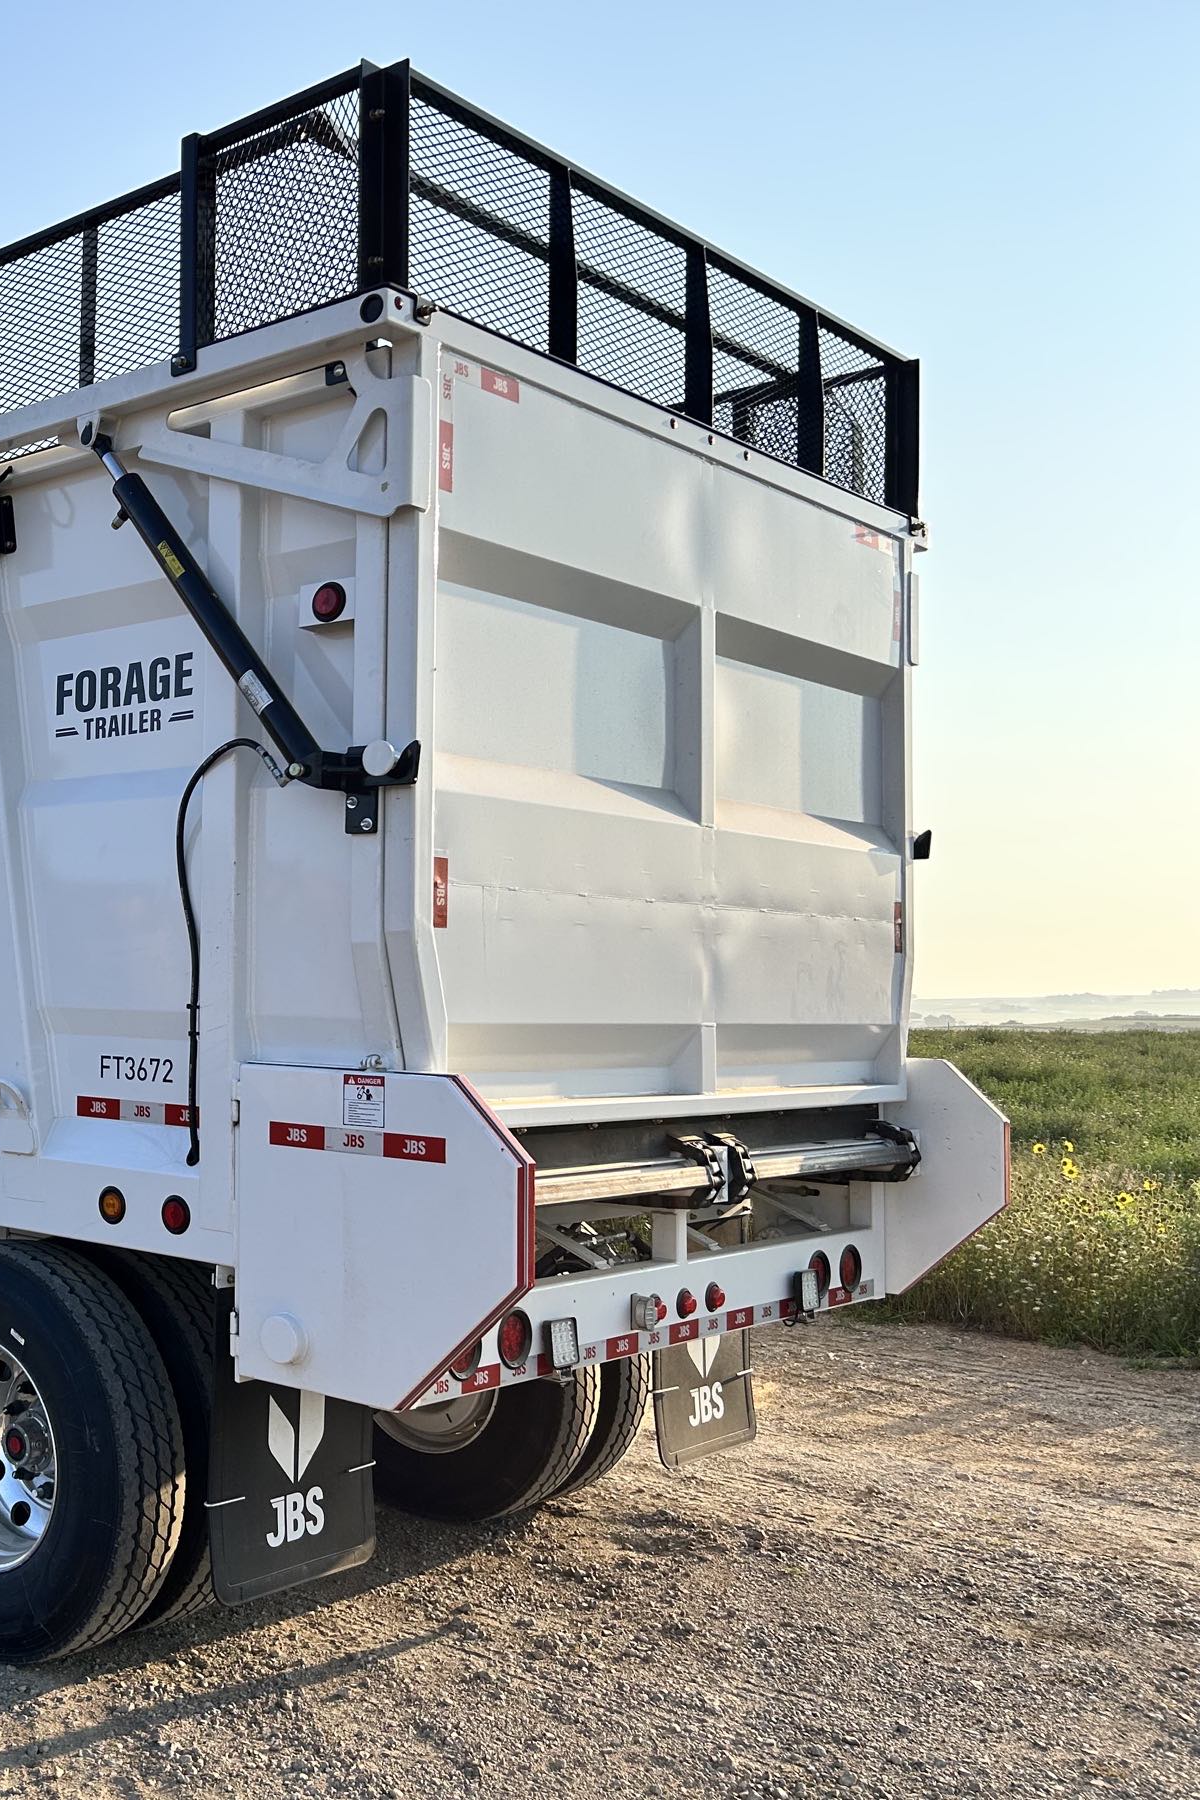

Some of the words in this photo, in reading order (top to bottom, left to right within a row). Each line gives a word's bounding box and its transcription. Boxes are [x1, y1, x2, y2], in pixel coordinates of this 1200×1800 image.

[443, 373, 452, 400] JBS
[454, 361, 469, 378] JBS
[493, 377, 508, 394] JBS
[441, 442, 451, 470] JBS
[56, 652, 194, 716] FORAGE
[83, 708, 162, 740] TRAILER
[100, 1055, 174, 1083] FT3672
[357, 1077, 382, 1085] DANGER
[90, 1101, 107, 1114] JBS
[134, 1105, 151, 1118] JBS
[179, 1109, 190, 1122] JB
[286, 1127, 307, 1143] JBS
[342, 1133, 365, 1149] JBS
[402, 1139, 426, 1155] JBS
[433, 1379, 449, 1395] JBS
[474, 1371, 489, 1386] JBS
[583, 1346, 596, 1360] JBS
[616, 1339, 629, 1353] JBS
[648, 1331, 660, 1345] JBS
[678, 1324, 690, 1338] JBS
[707, 1317, 719, 1331] JBS
[735, 1311, 746, 1324] JBS
[762, 1305, 772, 1318] JBS
[689, 1381, 725, 1427] JBS
[266, 1486, 325, 1548] JBS
